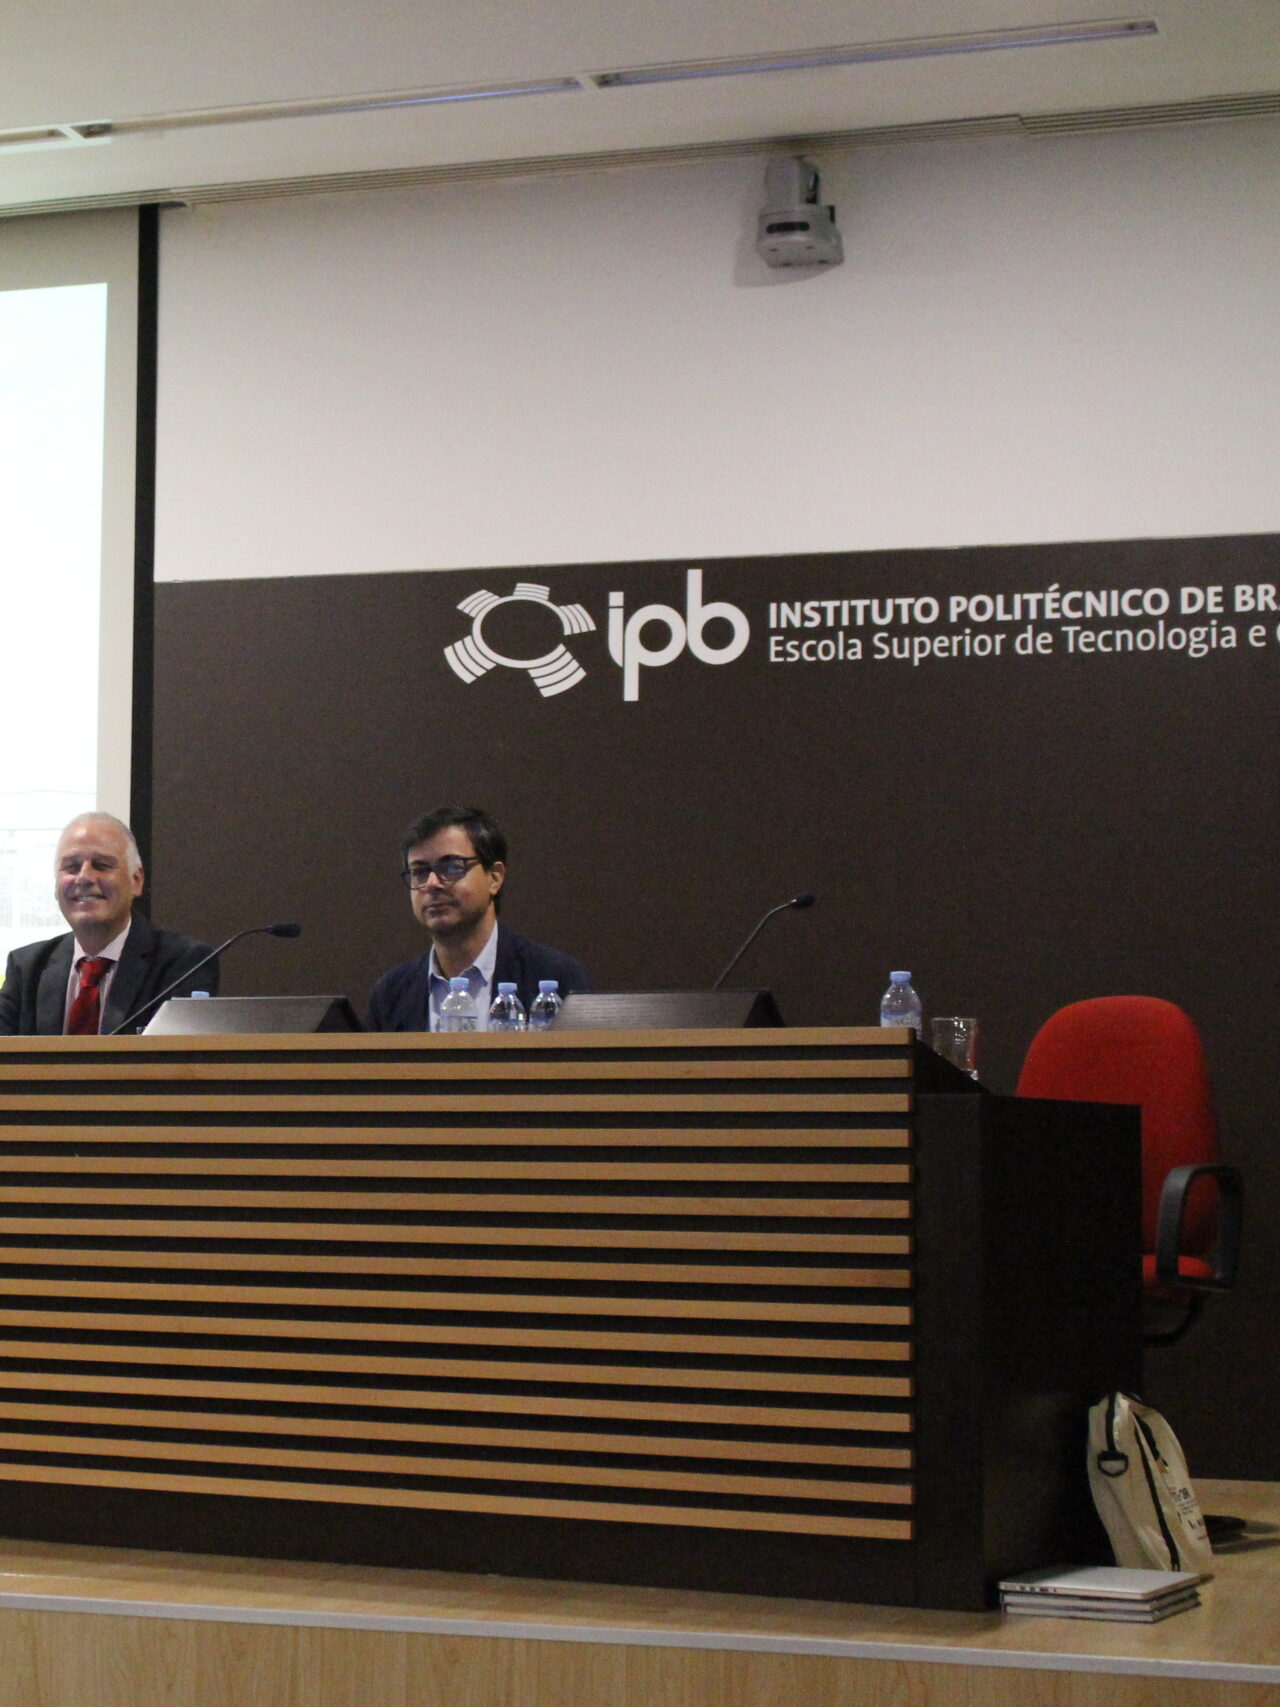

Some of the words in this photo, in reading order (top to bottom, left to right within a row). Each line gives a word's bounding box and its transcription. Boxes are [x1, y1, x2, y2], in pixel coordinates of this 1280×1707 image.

[769, 596, 940, 629] INSTITUTO
[949, 582, 1170, 623] POLITÉCNICO
[1180, 585, 1224, 614] DE
[1234, 583, 1280, 613] BR
[608, 569, 750, 702] ipb
[769, 630, 863, 663] Escola
[872, 627, 1006, 666] Superior
[1014, 624, 1053, 655] de
[1061, 618, 1237, 658] Tecnologia
[1248, 624, 1267, 648] e
